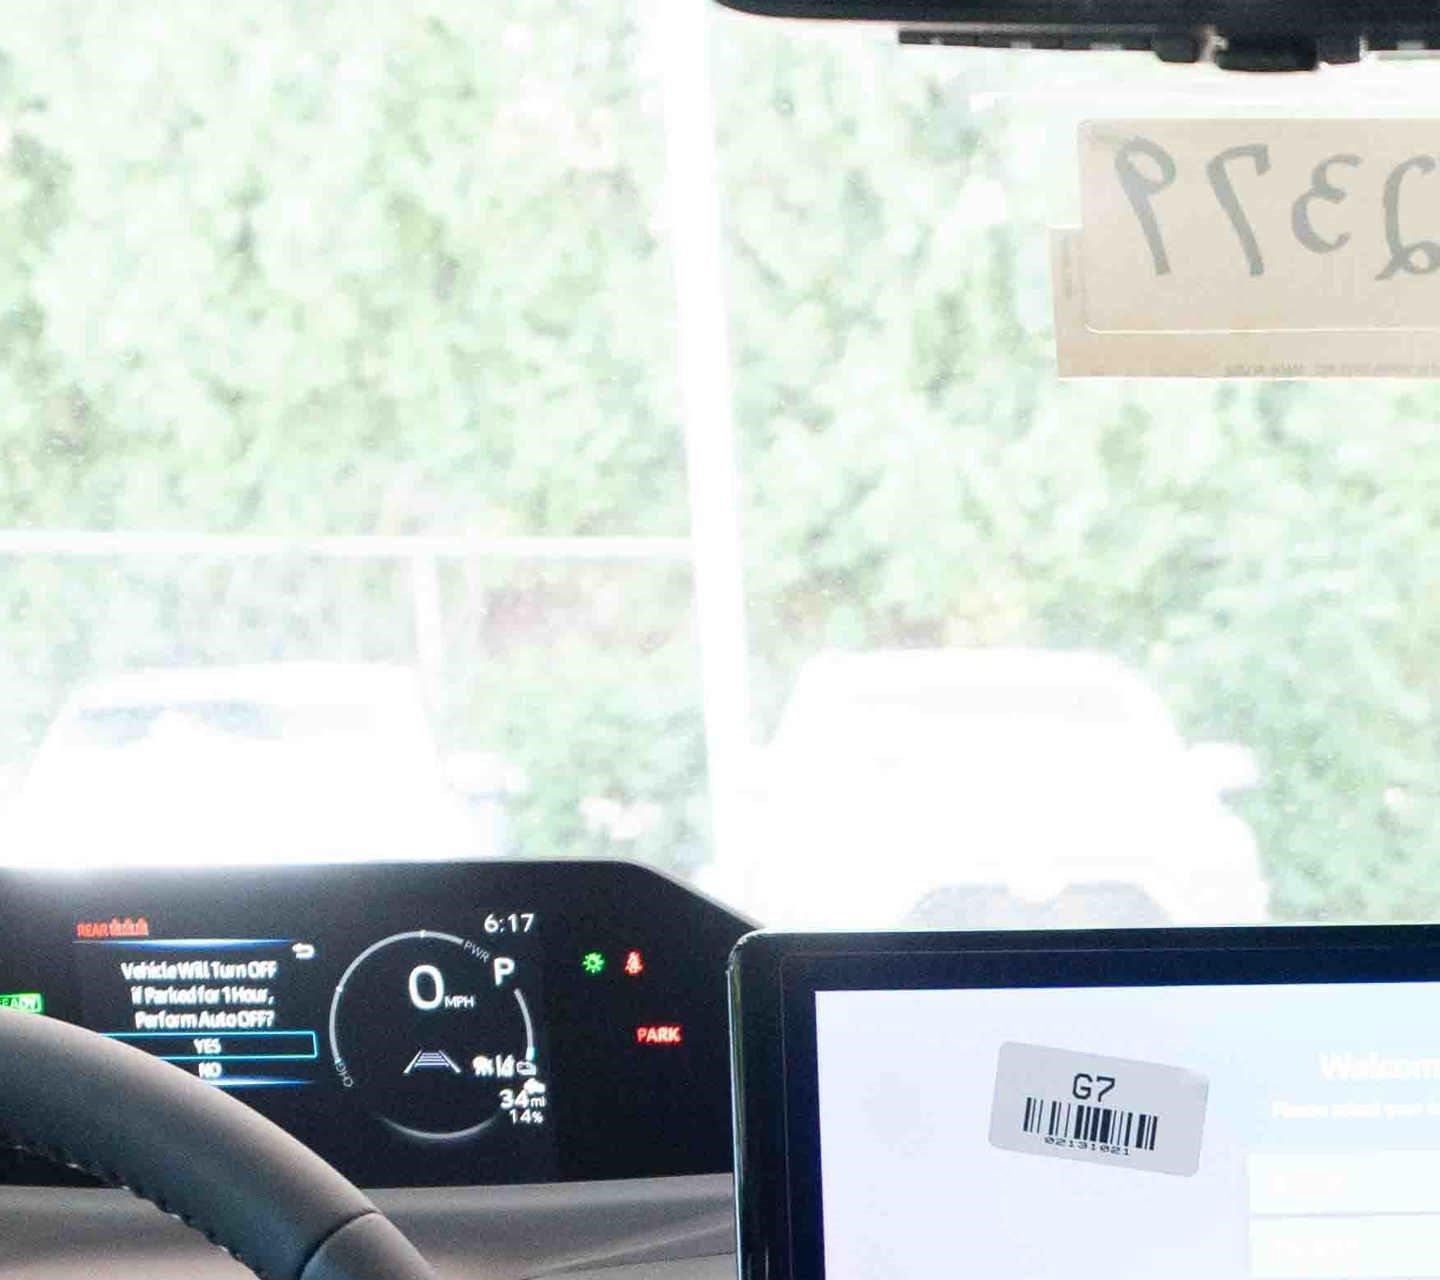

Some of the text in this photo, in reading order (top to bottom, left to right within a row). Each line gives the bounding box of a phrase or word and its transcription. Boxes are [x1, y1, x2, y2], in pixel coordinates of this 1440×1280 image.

[483, 913, 535, 933] 6:17
[120, 960, 278, 980] Vehicle Will Turn OFF
[494, 957, 516, 986] P
[144, 985, 196, 1004] Parked
[197, 985, 221, 1004] for
[222, 985, 231, 1004] 1
[408, 964, 474, 1010] 0 MPH
[134, 1010, 198, 1029] Perform
[199, 1009, 237, 1028] Auto
[637, 1026, 682, 1043] PARK
[193, 1037, 222, 1055] YES
[198, 1062, 222, 1078] NO
[1072, 1072, 1116, 1103] G7
[499, 1089, 529, 1109] 34
[510, 1109, 544, 1124] 14%
